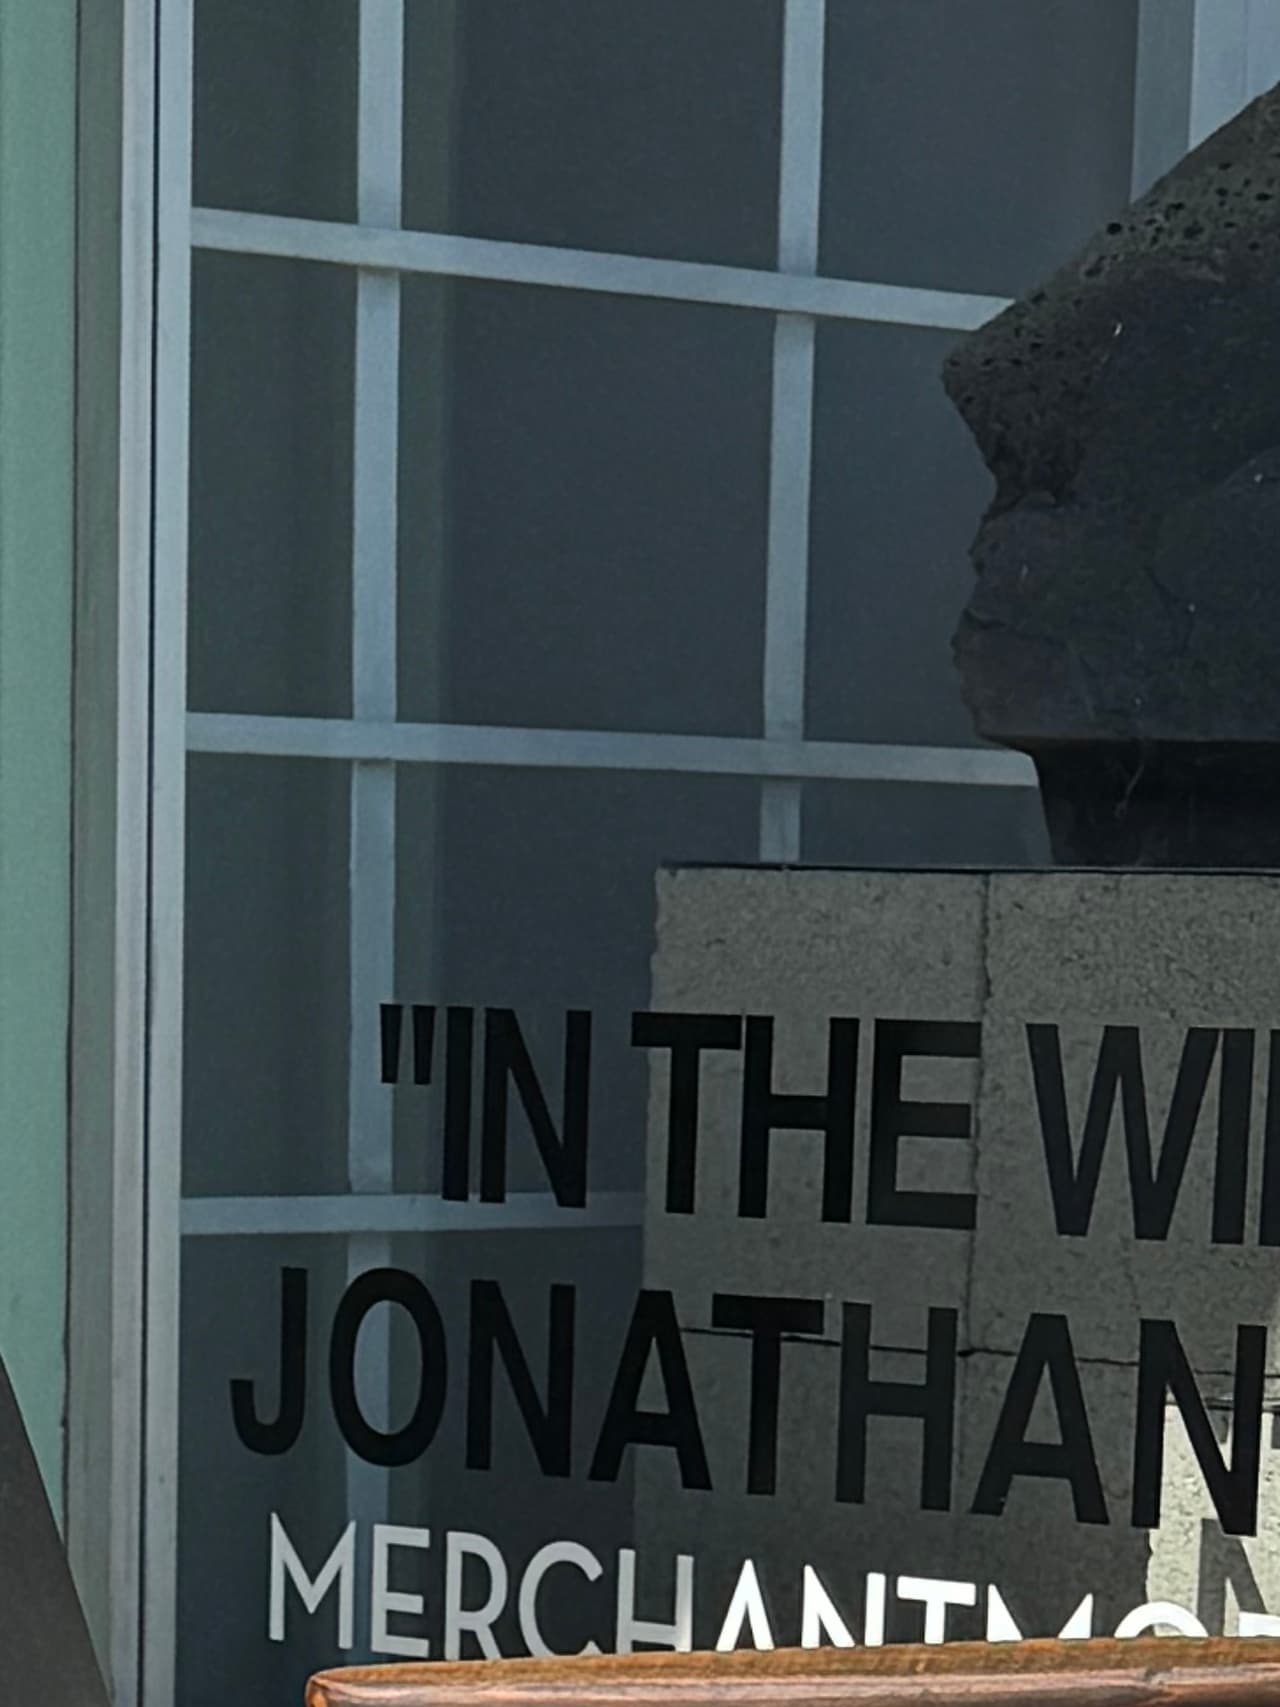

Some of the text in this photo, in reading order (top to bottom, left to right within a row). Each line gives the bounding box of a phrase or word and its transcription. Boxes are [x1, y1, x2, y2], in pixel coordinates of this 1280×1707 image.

[379, 1003, 593, 1209] "IN
[630, 1011, 983, 1230] THE
[229, 1265, 1265, 1538] JONATHAN
